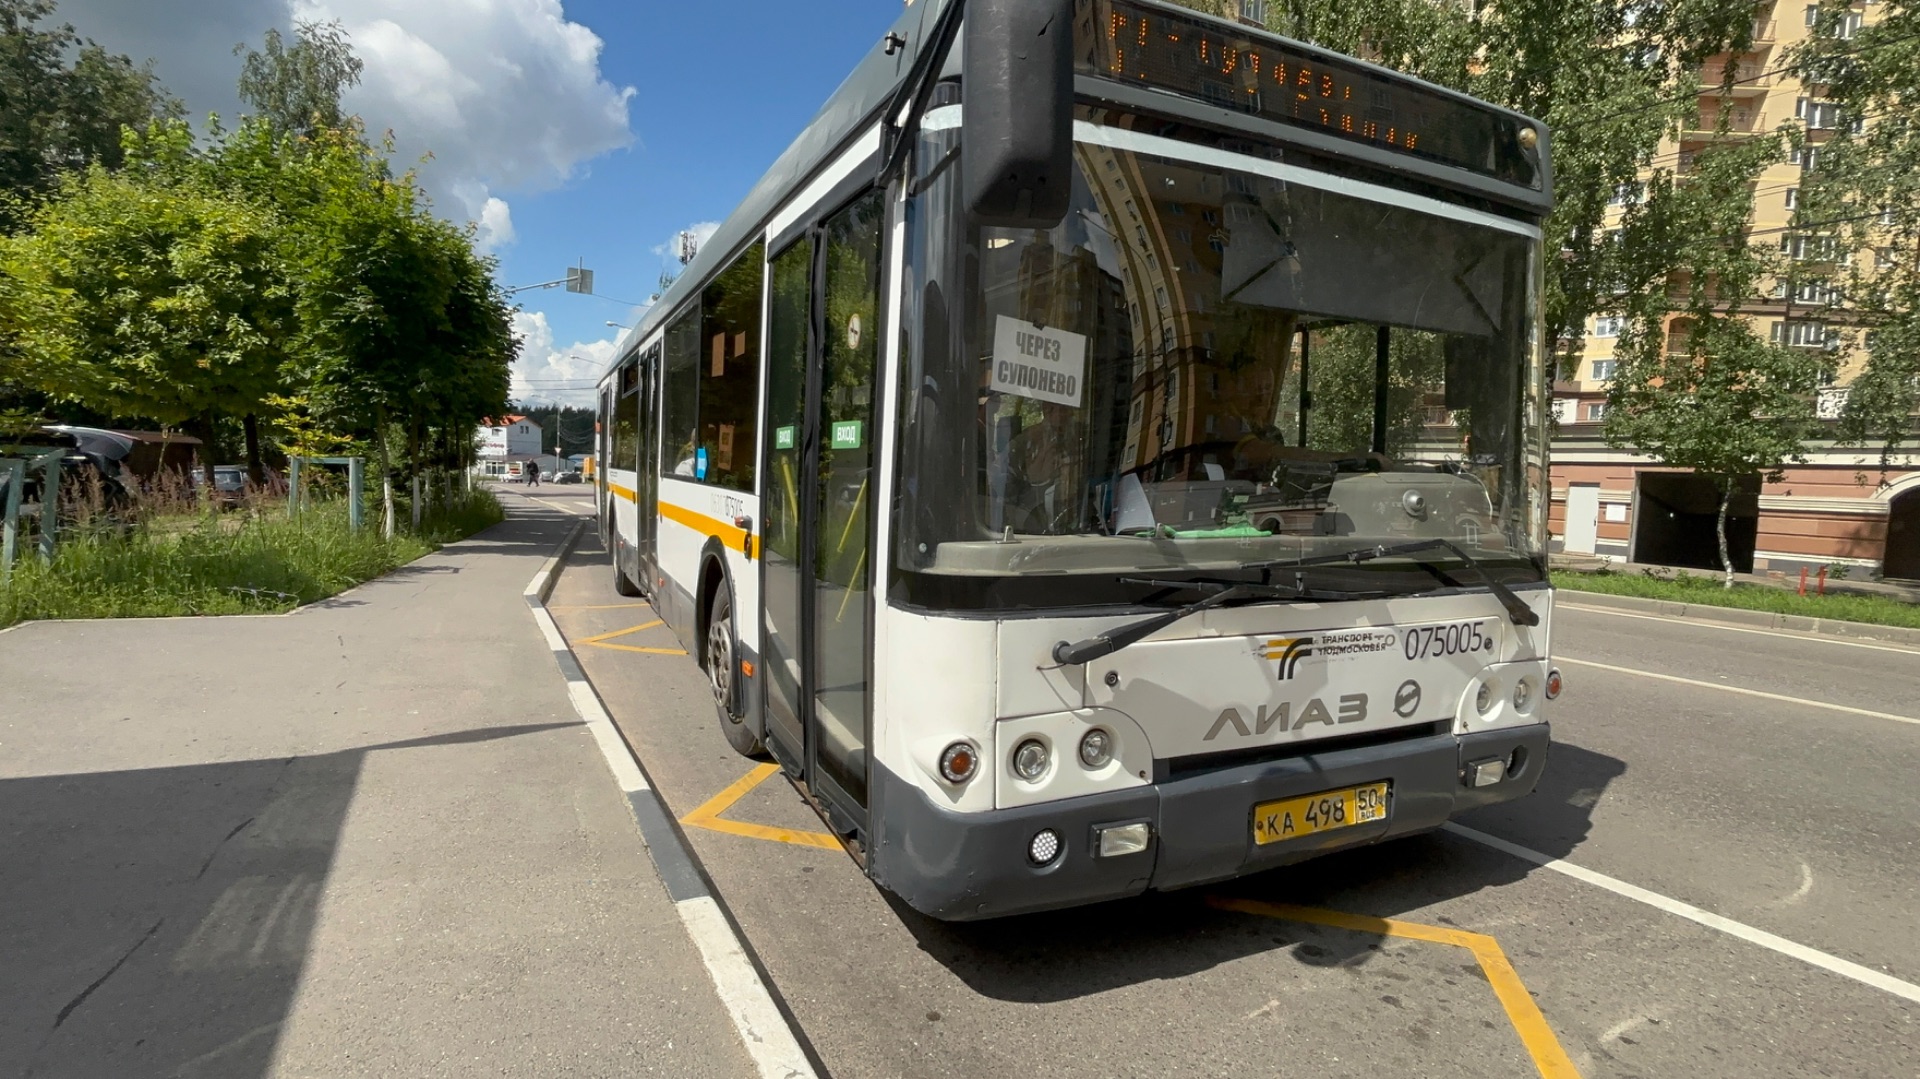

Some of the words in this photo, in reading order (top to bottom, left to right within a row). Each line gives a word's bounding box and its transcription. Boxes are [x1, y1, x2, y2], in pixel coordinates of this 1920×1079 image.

[1016, 331, 1061, 362] ЧЕРЕЗ
[997, 360, 1077, 397] СУПОНЕВО
[779, 429, 791, 445] ВХОД
[837, 426, 856, 444] ВХОД
[1321, 632, 1373, 644] ТРАНСПОРТ
[1405, 621, 1484, 661] 075005
[1203, 692, 1369, 741] ЛИАЗ
[1305, 796, 1345, 828] 498
[1358, 789, 1378, 810] 50
[1361, 809, 1376, 820] RUS
